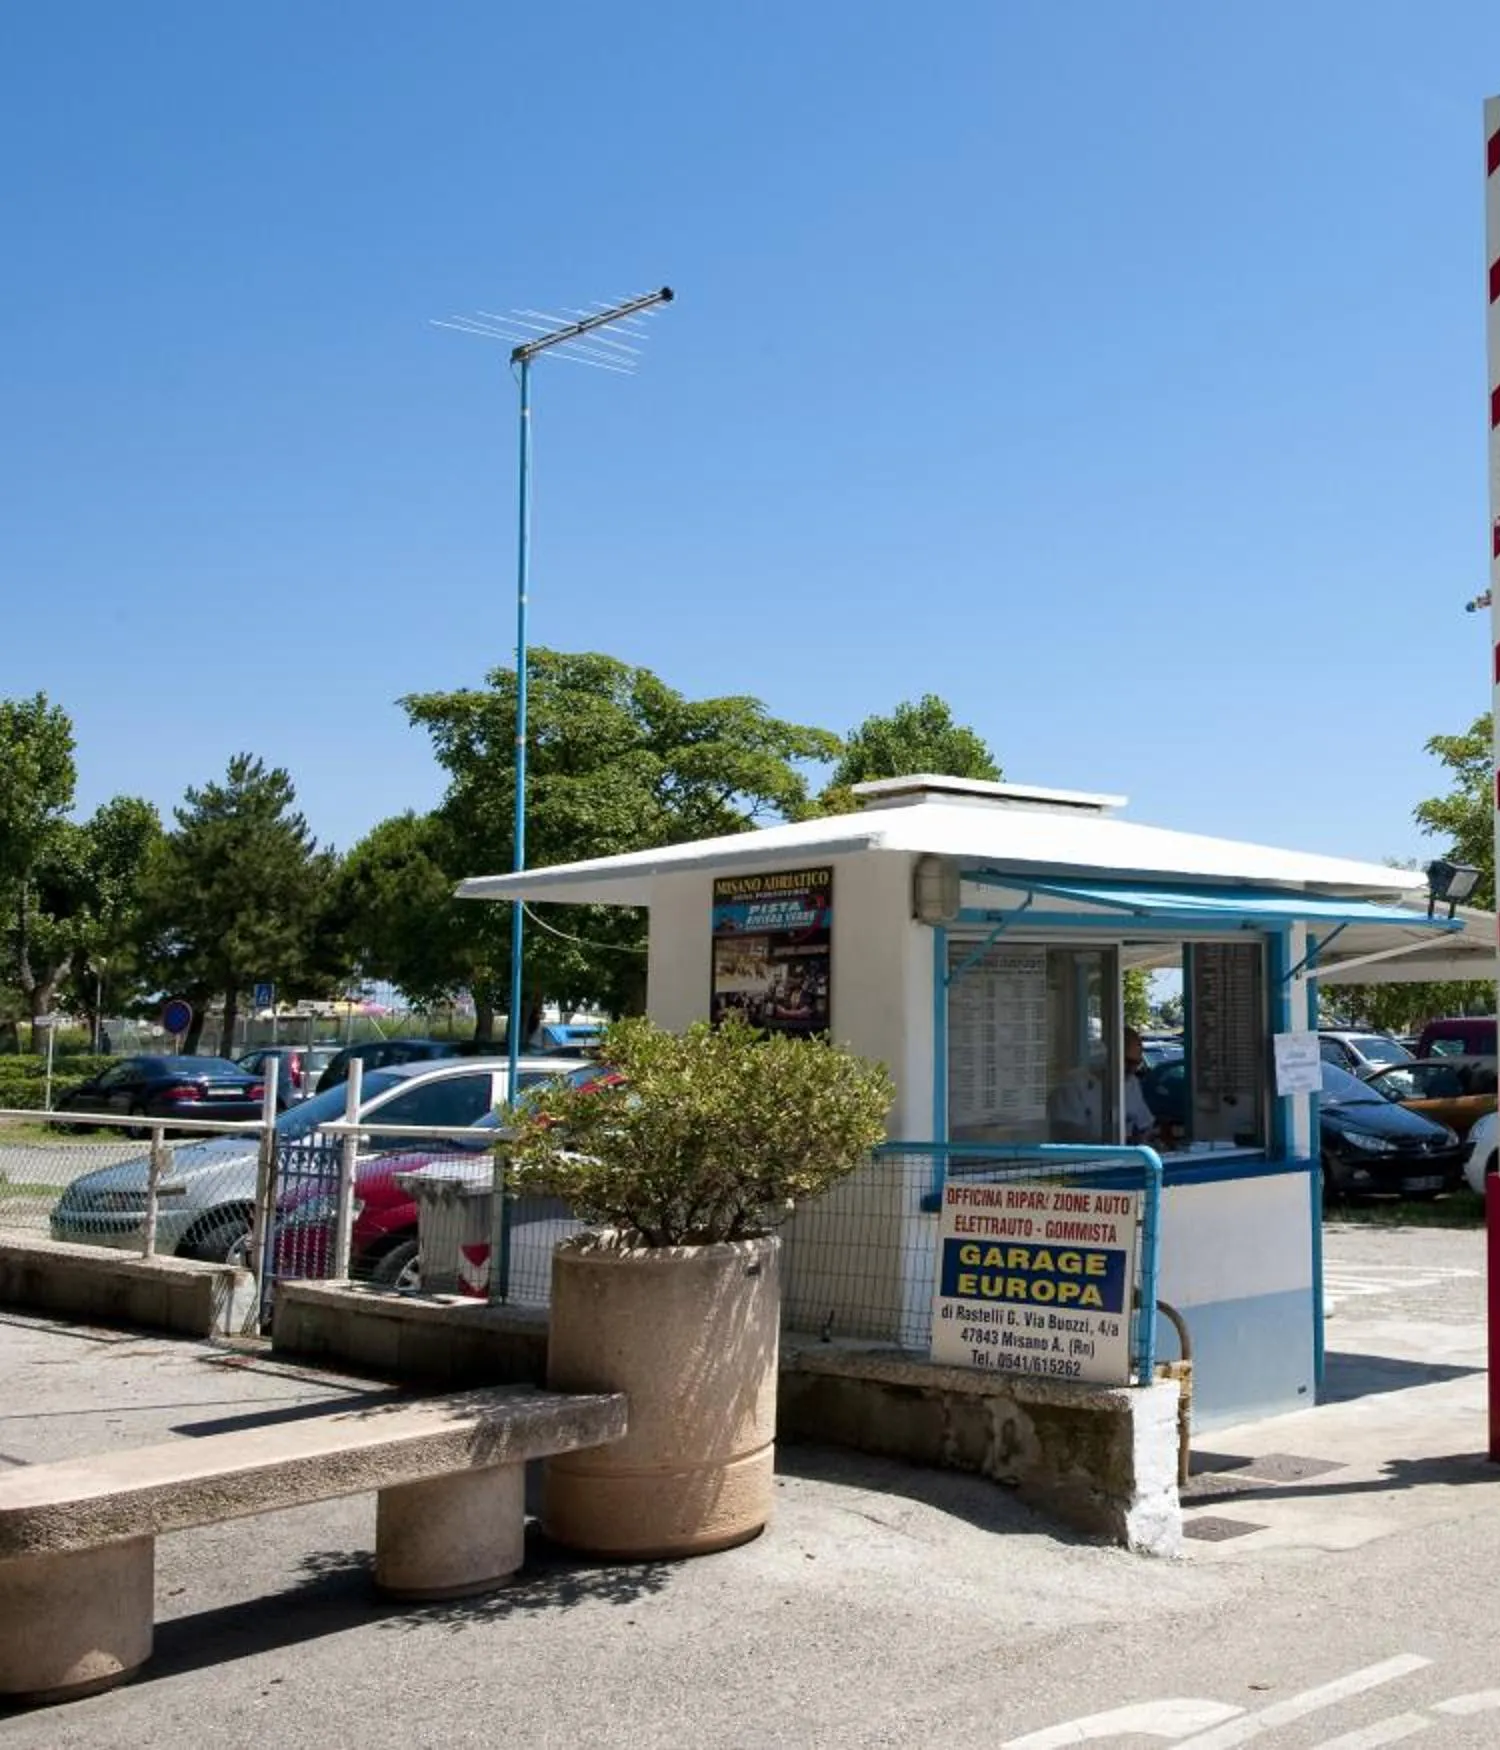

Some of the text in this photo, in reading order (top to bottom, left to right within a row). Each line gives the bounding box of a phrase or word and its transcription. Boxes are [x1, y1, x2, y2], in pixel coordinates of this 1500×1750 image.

[716, 878, 761, 896] MISANO
[763, 871, 829, 891] ADRIATICO
[748, 901, 801, 914] PISTA
[947, 1187, 1003, 1207] OFFICINA
[1094, 1195, 1131, 1214] AUTO
[954, 1215, 1033, 1237] ELETTRAUTO
[1045, 1219, 1117, 1243] GOMMISTA
[959, 1243, 1108, 1277] GARAGE
[958, 1272, 1104, 1307] EUROPA
[941, 1304, 953, 1319] di
[956, 1305, 1004, 1325] Rastelli
[1007, 1311, 1020, 1326] G.
[1024, 1311, 1045, 1329] Via
[1098, 1320, 1119, 1337] 4/a
[960, 1328, 1096, 1360] 47843 Misano A. (Rn)
[971, 1350, 1082, 1377] Tel. 0541/615262
